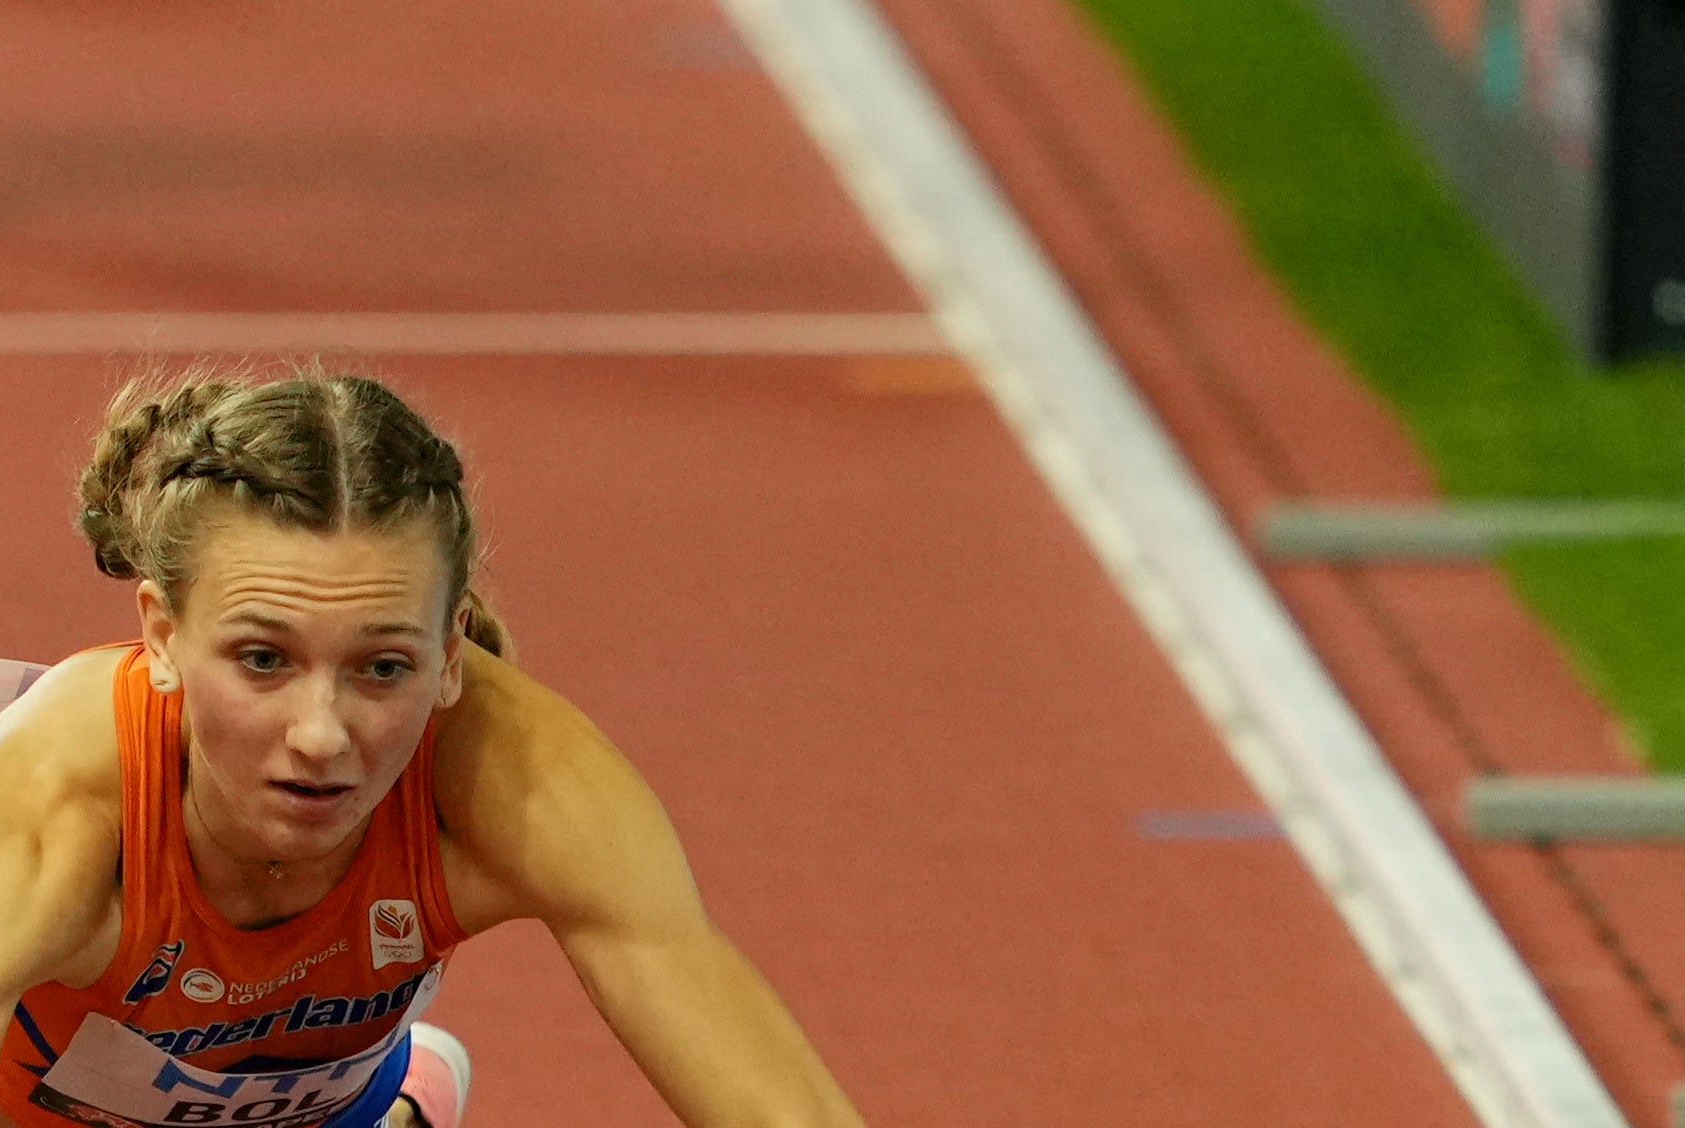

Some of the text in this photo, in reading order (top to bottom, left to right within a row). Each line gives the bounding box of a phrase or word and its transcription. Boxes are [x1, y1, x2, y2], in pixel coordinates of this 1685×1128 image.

[229, 939, 349, 994] NEDEANDSE
[124, 972, 424, 1058] ederland
[163, 1089, 336, 1124] BOL
